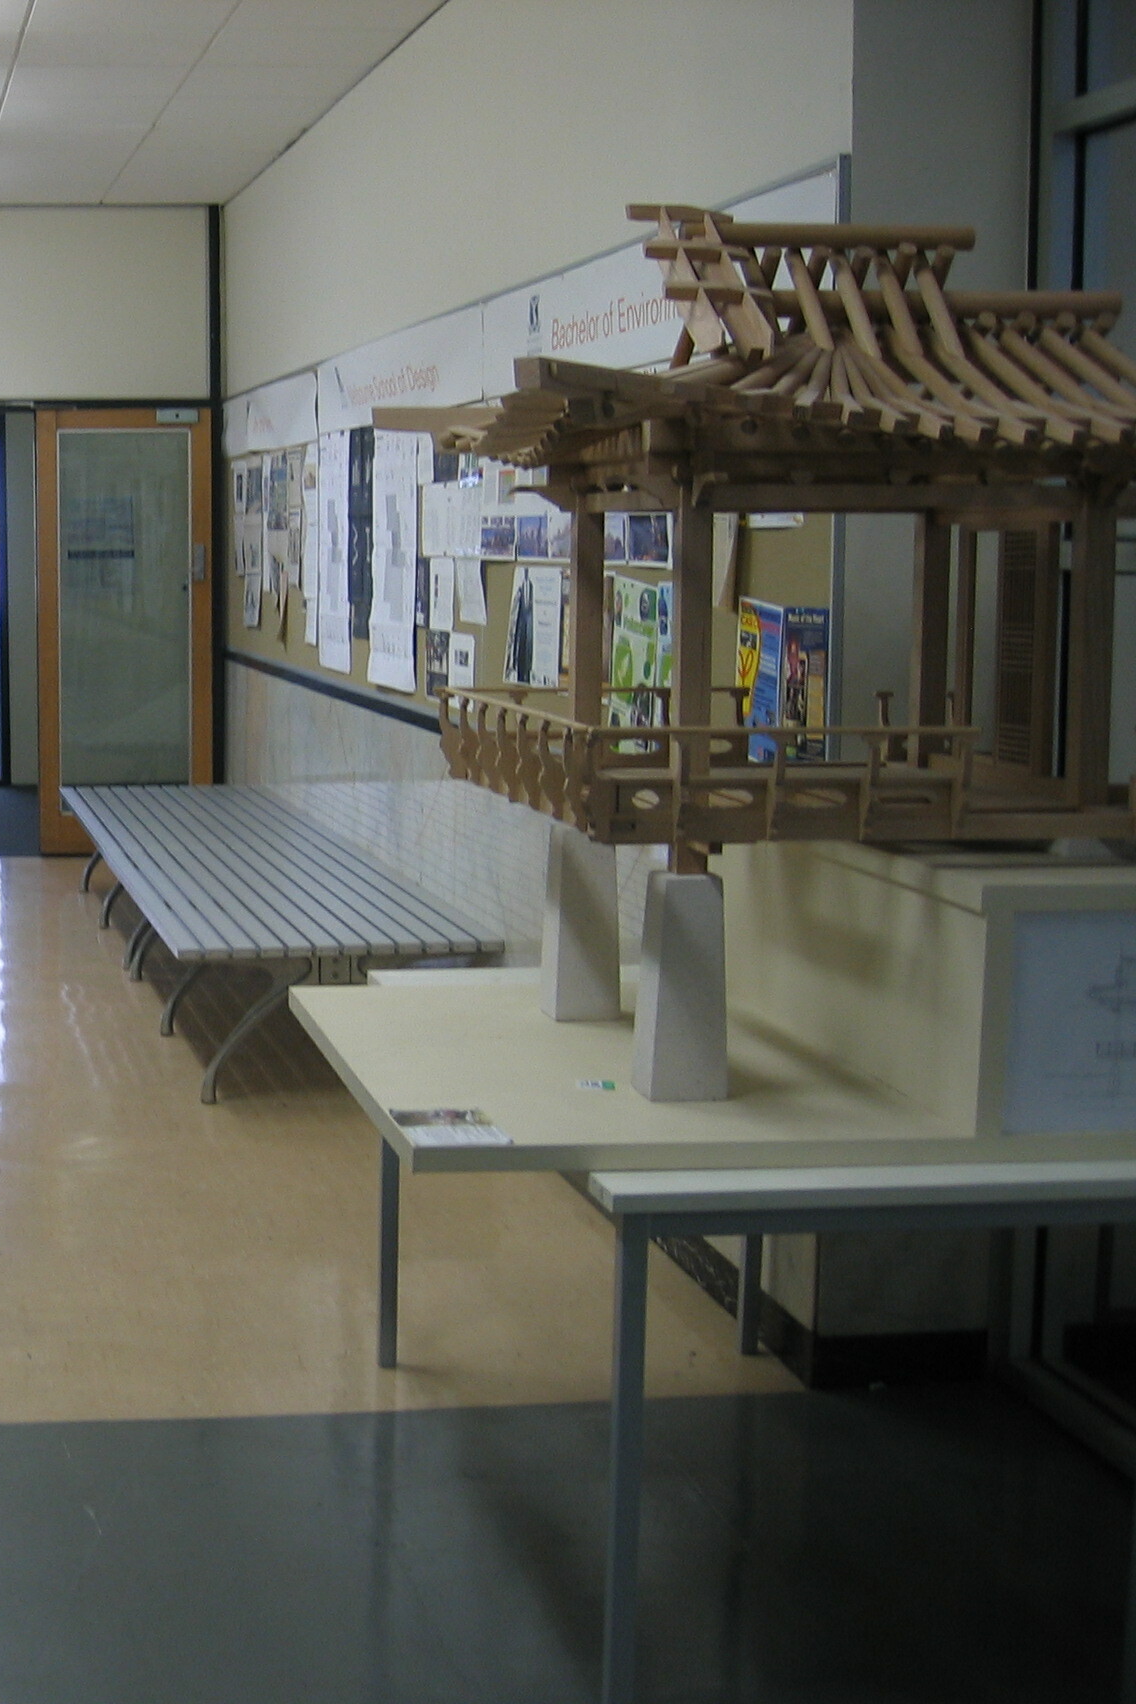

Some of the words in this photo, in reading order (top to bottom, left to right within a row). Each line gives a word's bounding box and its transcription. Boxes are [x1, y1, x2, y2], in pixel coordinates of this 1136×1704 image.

[551, 309, 600, 351] Bachelor
[602, 300, 614, 338] of
[406, 364, 439, 393] Design
